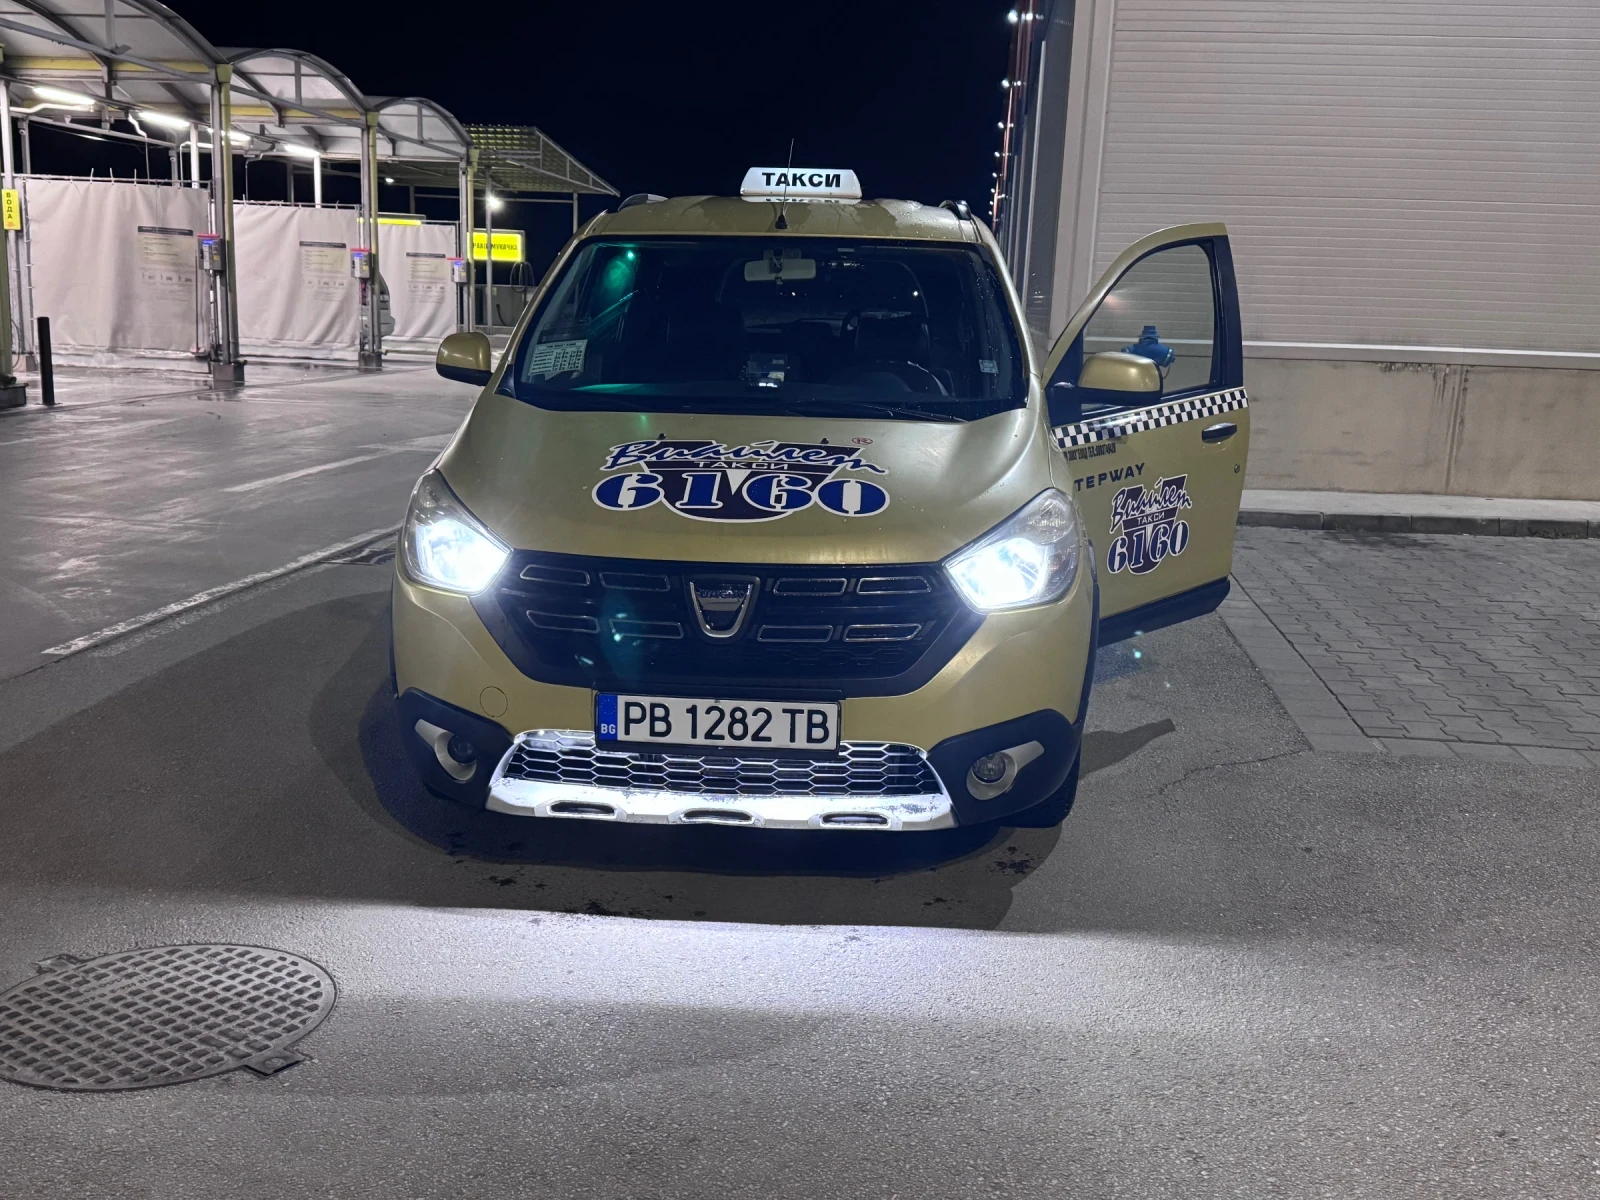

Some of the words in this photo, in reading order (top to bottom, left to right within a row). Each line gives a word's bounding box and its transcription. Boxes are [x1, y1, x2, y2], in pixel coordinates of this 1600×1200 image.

[762, 172, 841, 188] ТАКСИ
[472, 242, 518, 250] РАХМУКАЧКА
[693, 461, 789, 471] ТАКСИ
[1073, 463, 1145, 492] TEPWAY
[591, 472, 891, 517] 6160
[1136, 512, 1165, 526] ТАКСИ
[1107, 520, 1190, 574] 6160
[600, 723, 616, 735] BG
[623, 701, 672, 738] PB
[685, 704, 773, 742] 1282
[782, 708, 830, 744] TB
